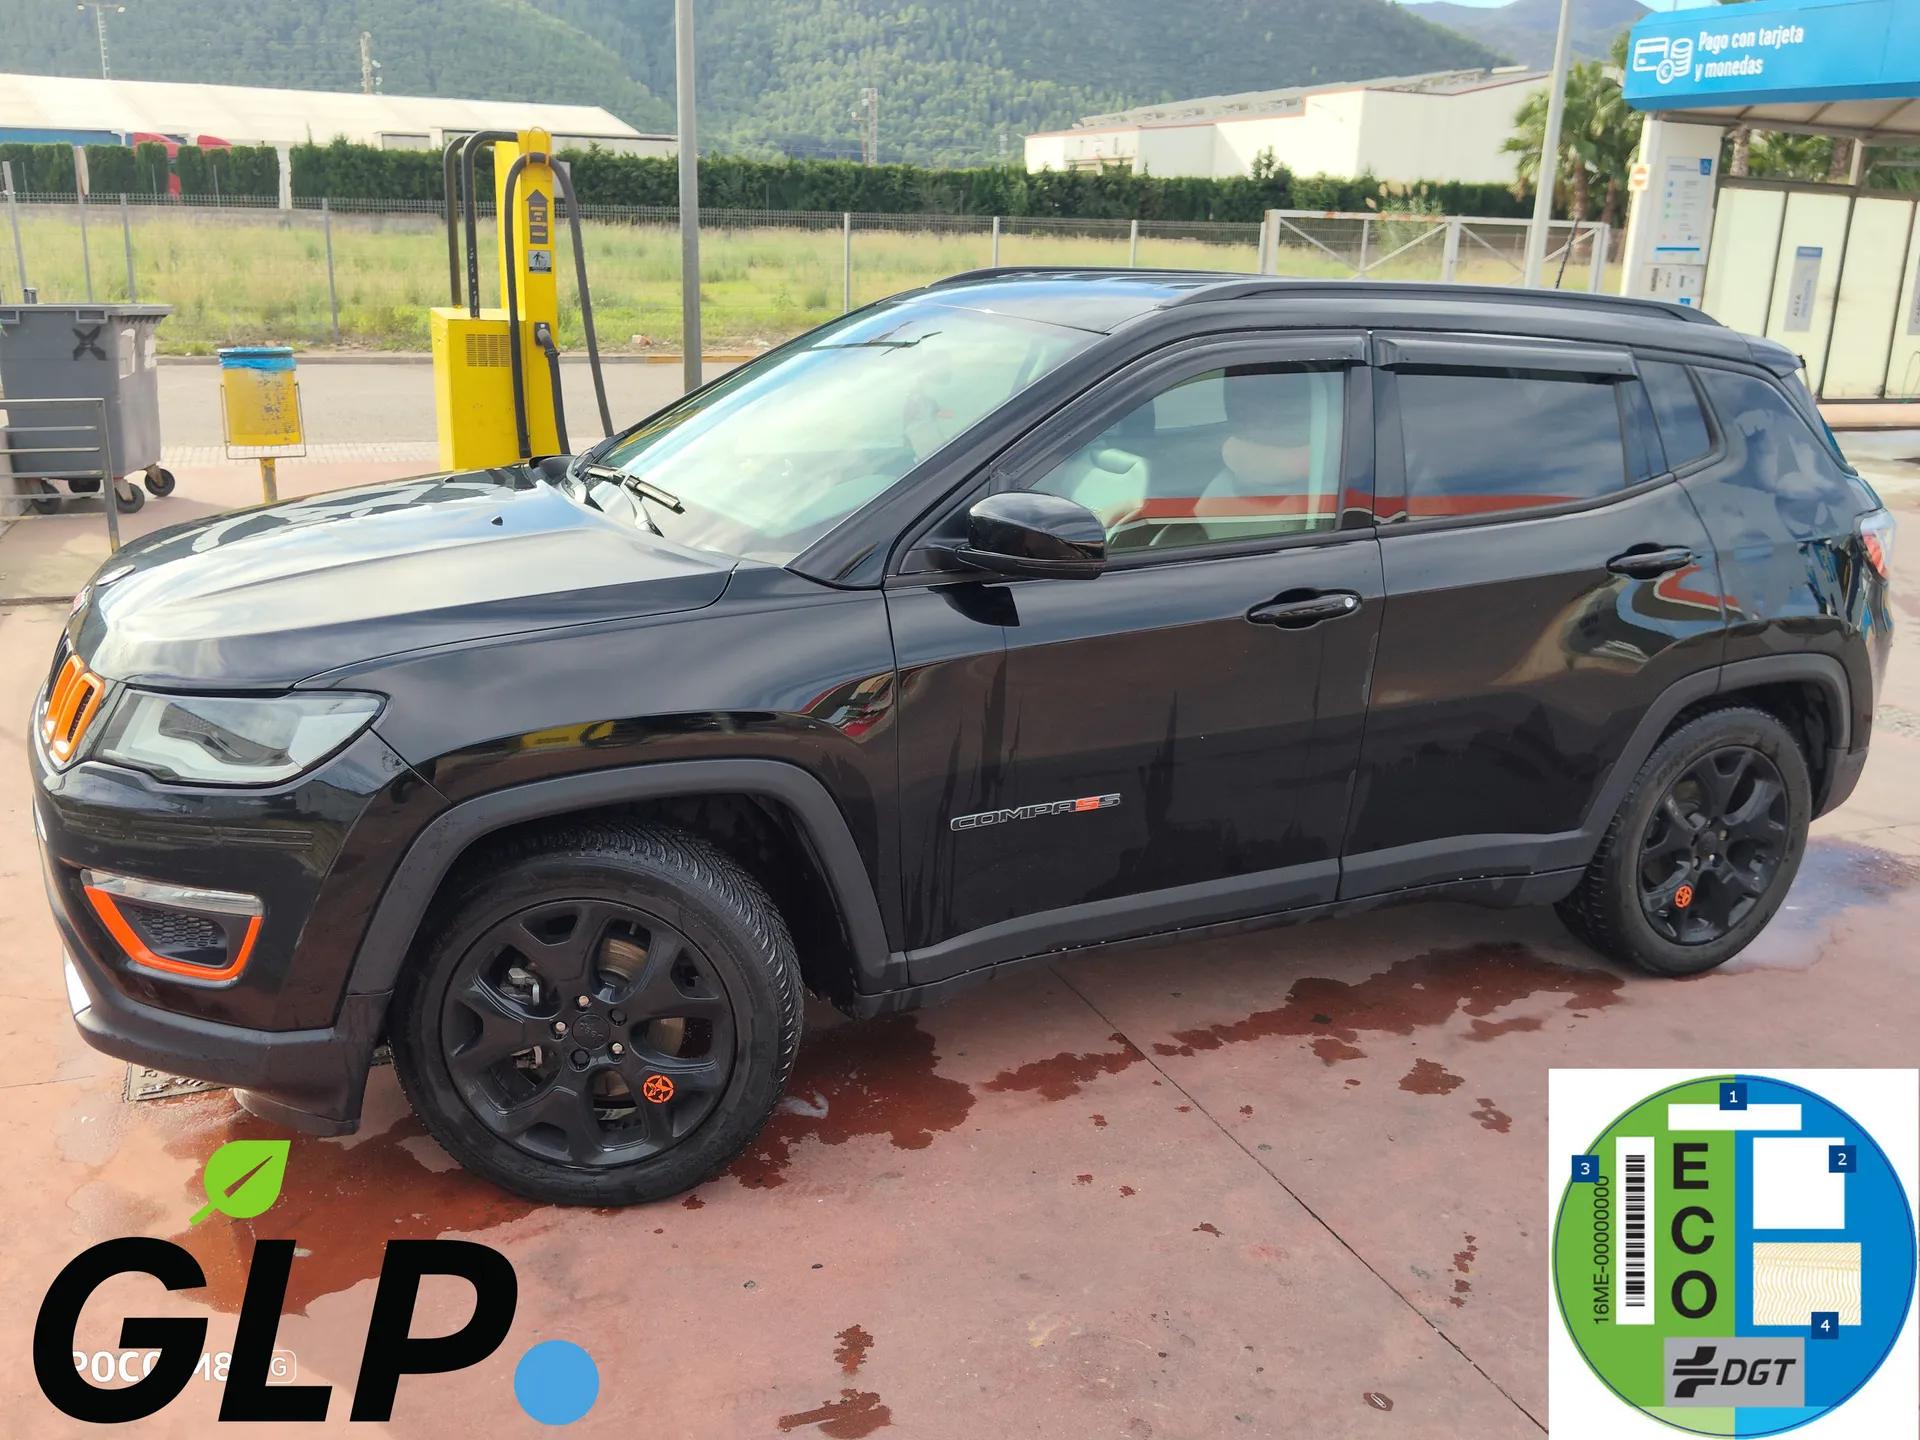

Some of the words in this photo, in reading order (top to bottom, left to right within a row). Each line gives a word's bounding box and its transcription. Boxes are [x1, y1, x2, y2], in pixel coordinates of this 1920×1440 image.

[1698, 31, 1729, 54] Pago
[1731, 31, 1756, 48] con
[1758, 24, 1804, 50] tarjeta
[1694, 63, 1704, 82] y
[1705, 54, 1763, 78] monedas
[951, 793, 1121, 831] COMPASS
